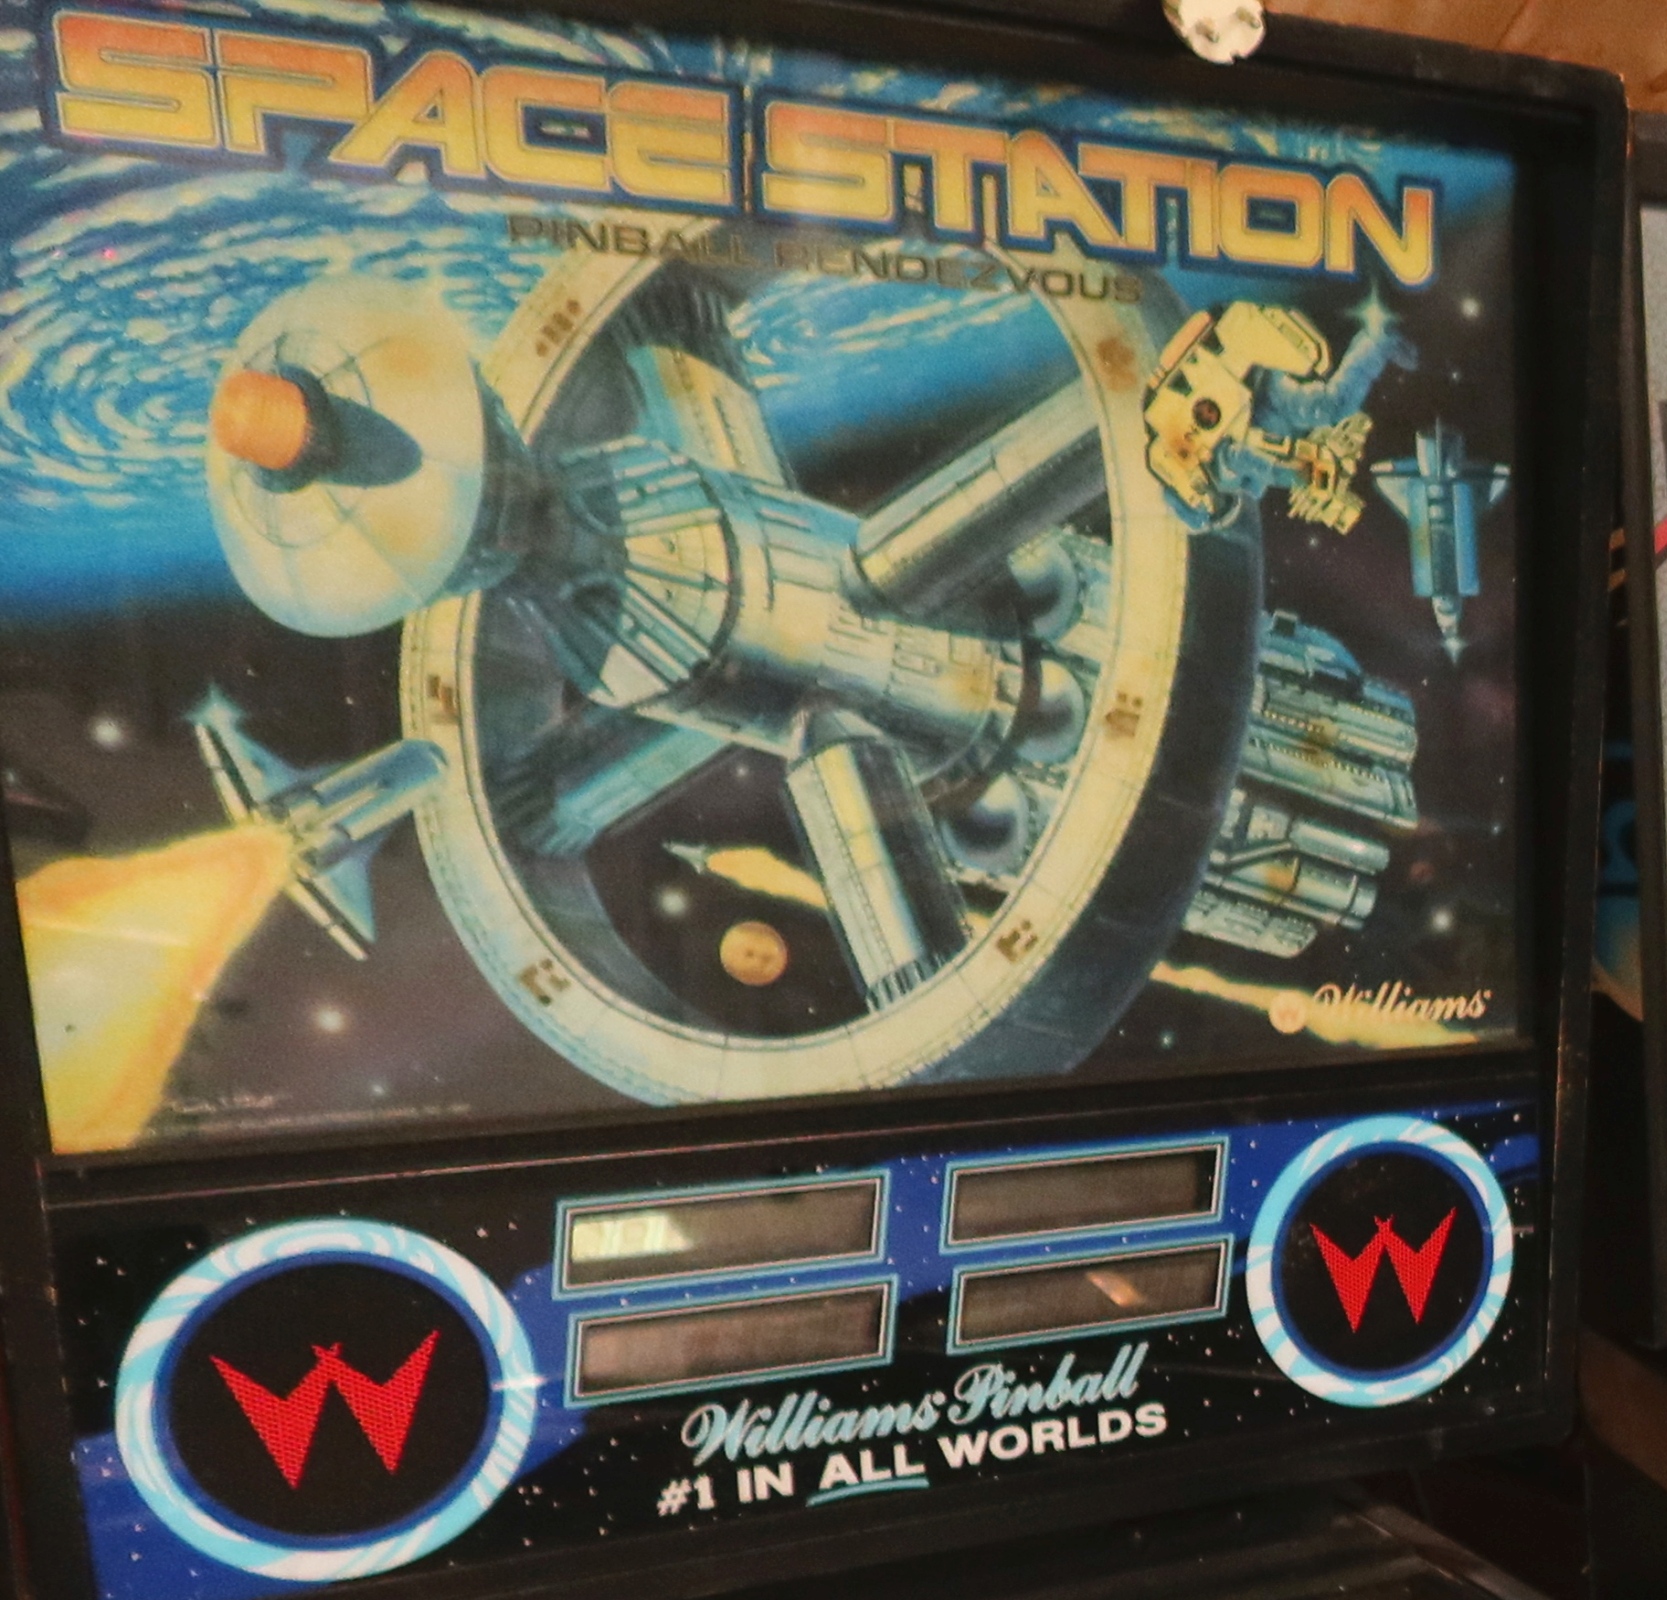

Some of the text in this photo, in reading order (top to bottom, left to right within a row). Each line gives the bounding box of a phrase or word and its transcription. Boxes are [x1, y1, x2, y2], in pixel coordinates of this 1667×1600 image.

[54, 10, 1434, 286] SPACE STATION
[507, 213, 1143, 304] PINBALL RENDEZVOUS
[1313, 981, 1492, 1022] Williams
[657, 1402, 1167, 1516] #1 IN ALL WORLDS
[681, 1343, 1149, 1465] Williams Pinball
